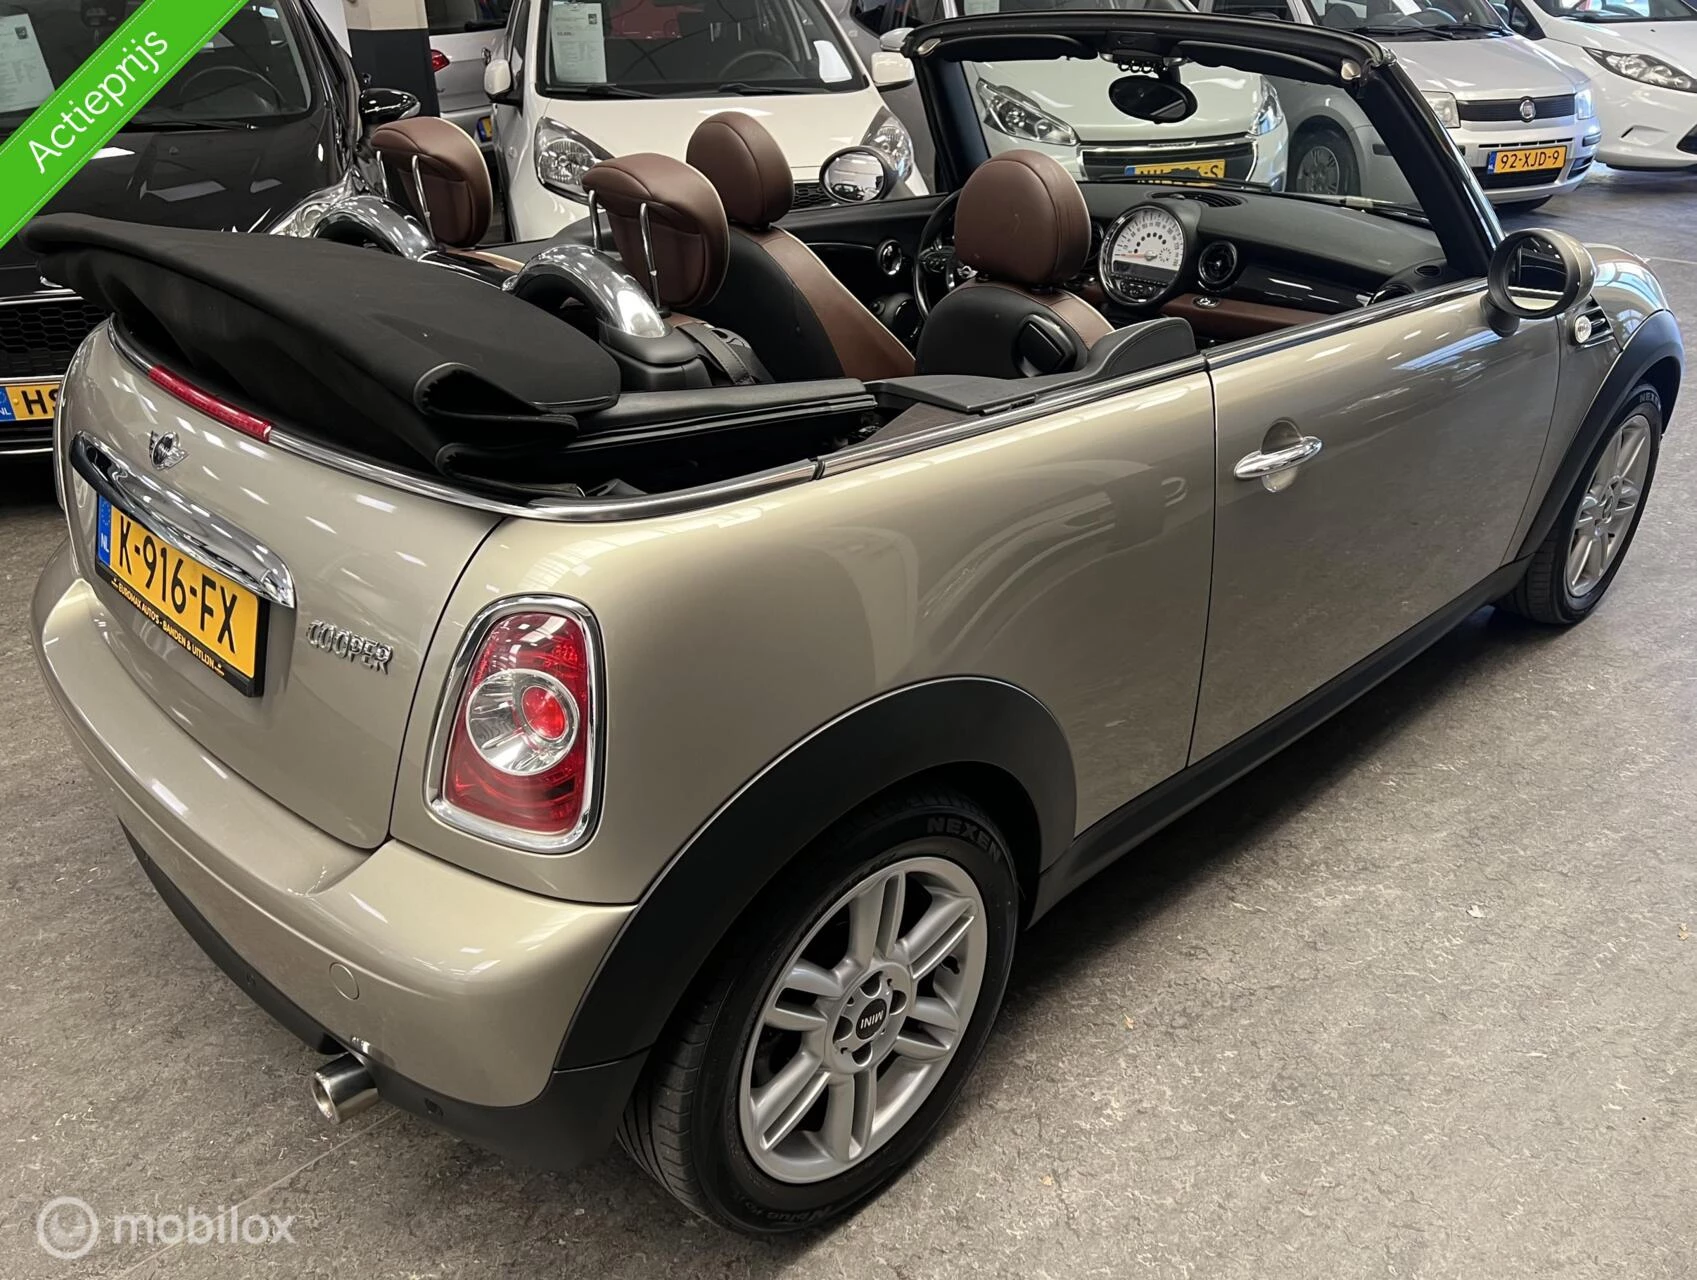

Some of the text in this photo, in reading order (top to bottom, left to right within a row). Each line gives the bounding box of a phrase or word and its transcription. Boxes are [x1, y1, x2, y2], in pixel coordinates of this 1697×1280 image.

[1500, 150, 1560, 170] 92-XJD-9
[100, 531, 110, 554] NL
[119, 515, 239, 656] K-916-FX
[163, 620, 186, 646] BANDEN
[306, 620, 393, 676] COOPER
[927, 817, 1002, 864] NEXEN
[860, 1009, 884, 1030] MINI
